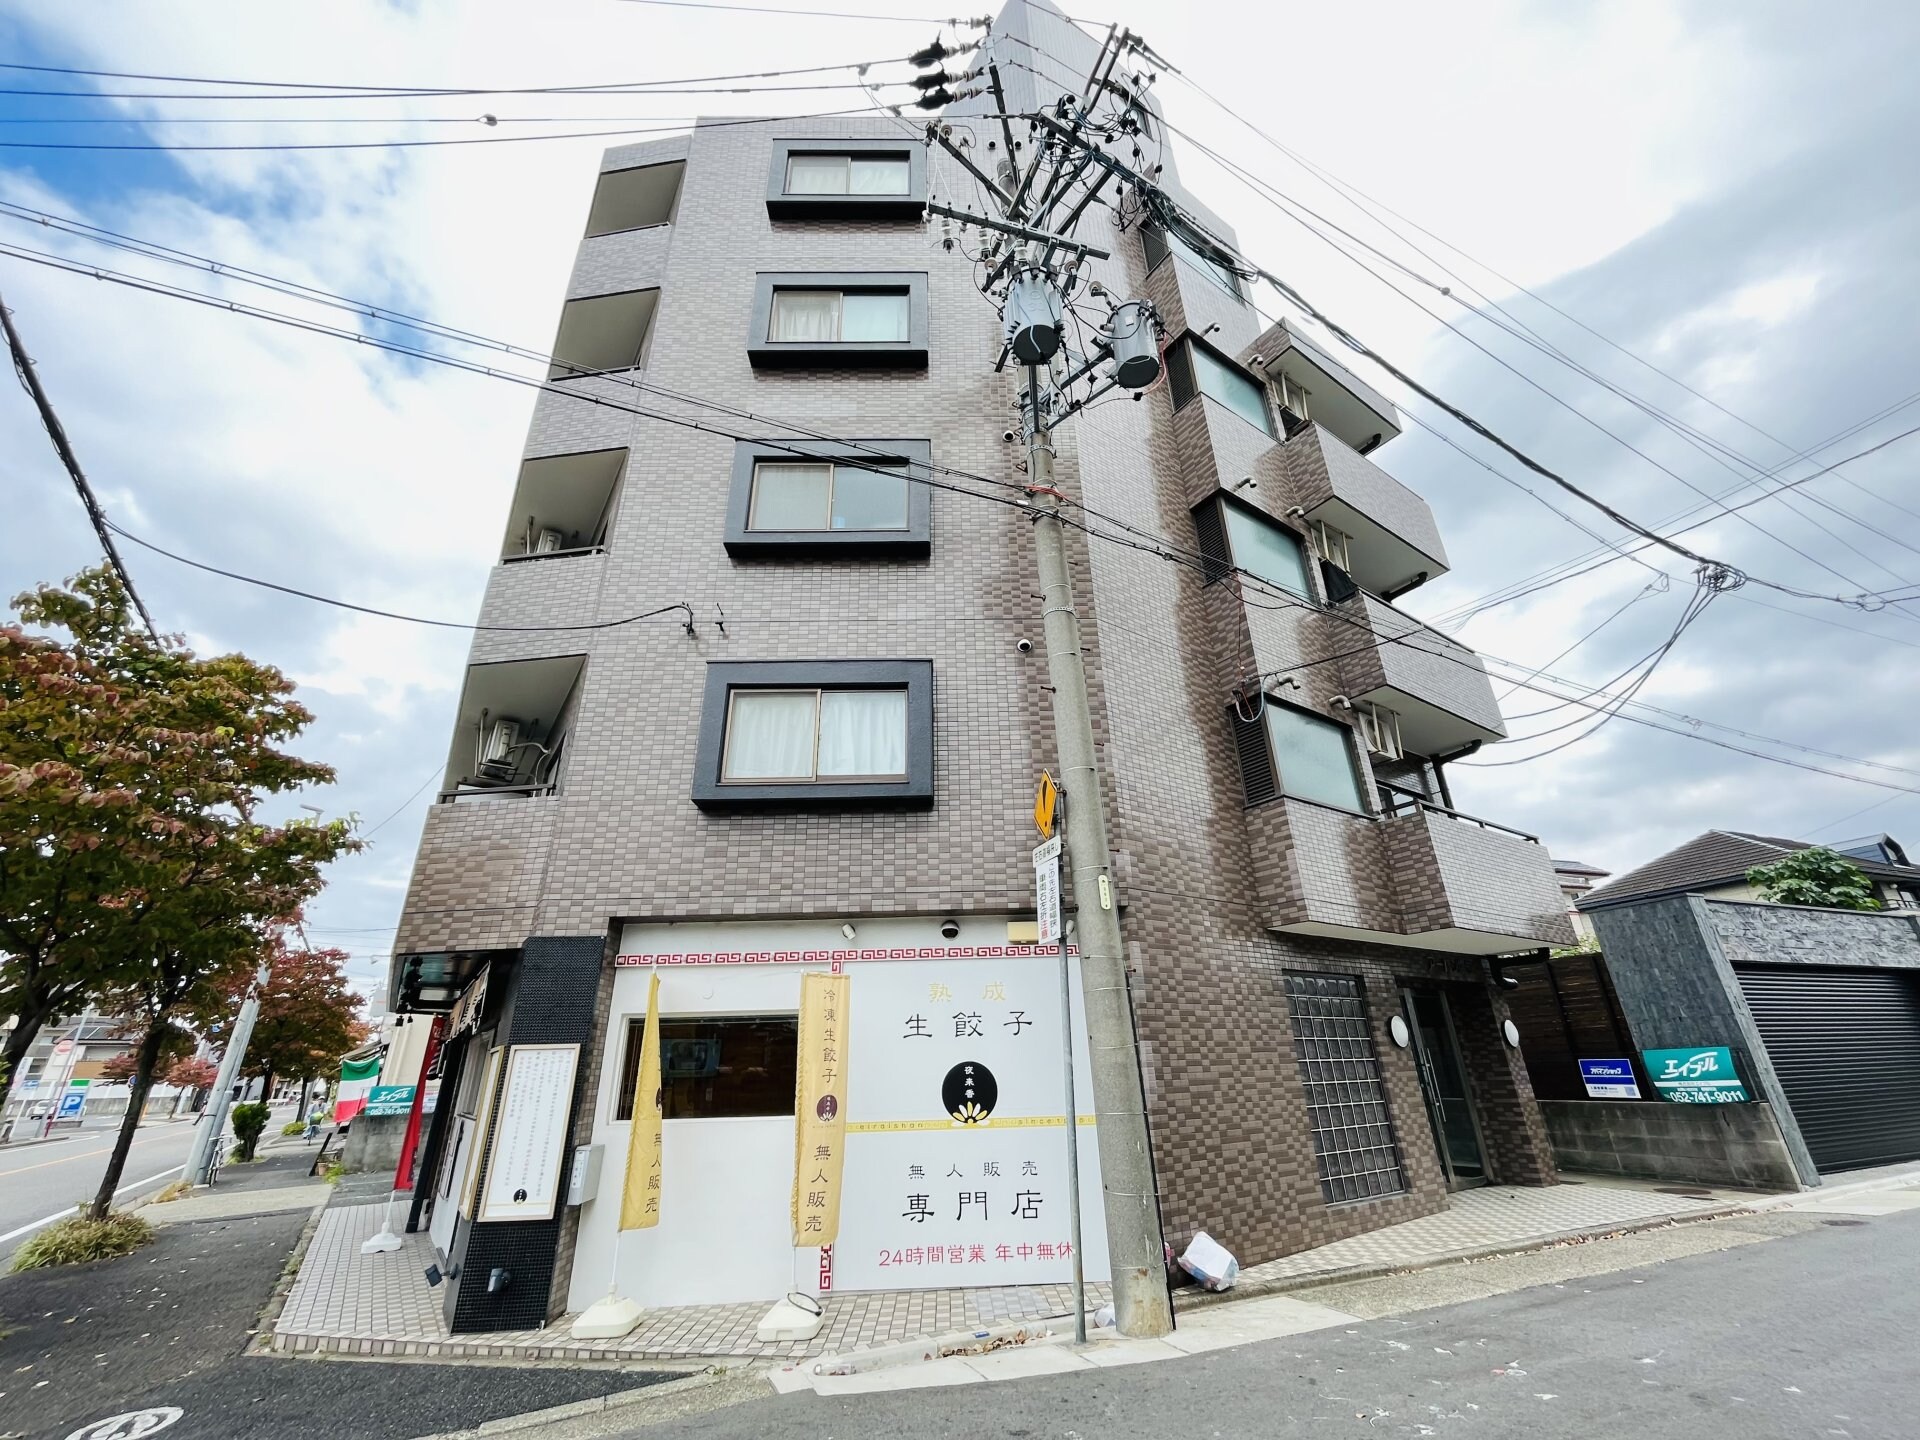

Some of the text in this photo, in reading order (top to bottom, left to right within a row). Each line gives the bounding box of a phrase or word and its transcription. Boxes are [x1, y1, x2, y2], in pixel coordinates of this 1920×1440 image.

[928, 981, 1005, 1003] 熟成
[822, 988, 838, 1084] 冷凍生餃子
[903, 1011, 1032, 1039] 生餃子
[1660, 1051, 1719, 1079] エイブル
[372, 1087, 411, 1102] エイブル
[964, 1066, 975, 1098] 夜来香
[63, 1096, 81, 1109] P
[1669, 1090, 1744, 1103] 052-741-9011
[908, 1161, 1038, 1179] 無人販売
[804, 1144, 831, 1232] 無人販売
[902, 1189, 1043, 1223] 専門店
[879, 1241, 1072, 1266] 24時間営業 年中無休
